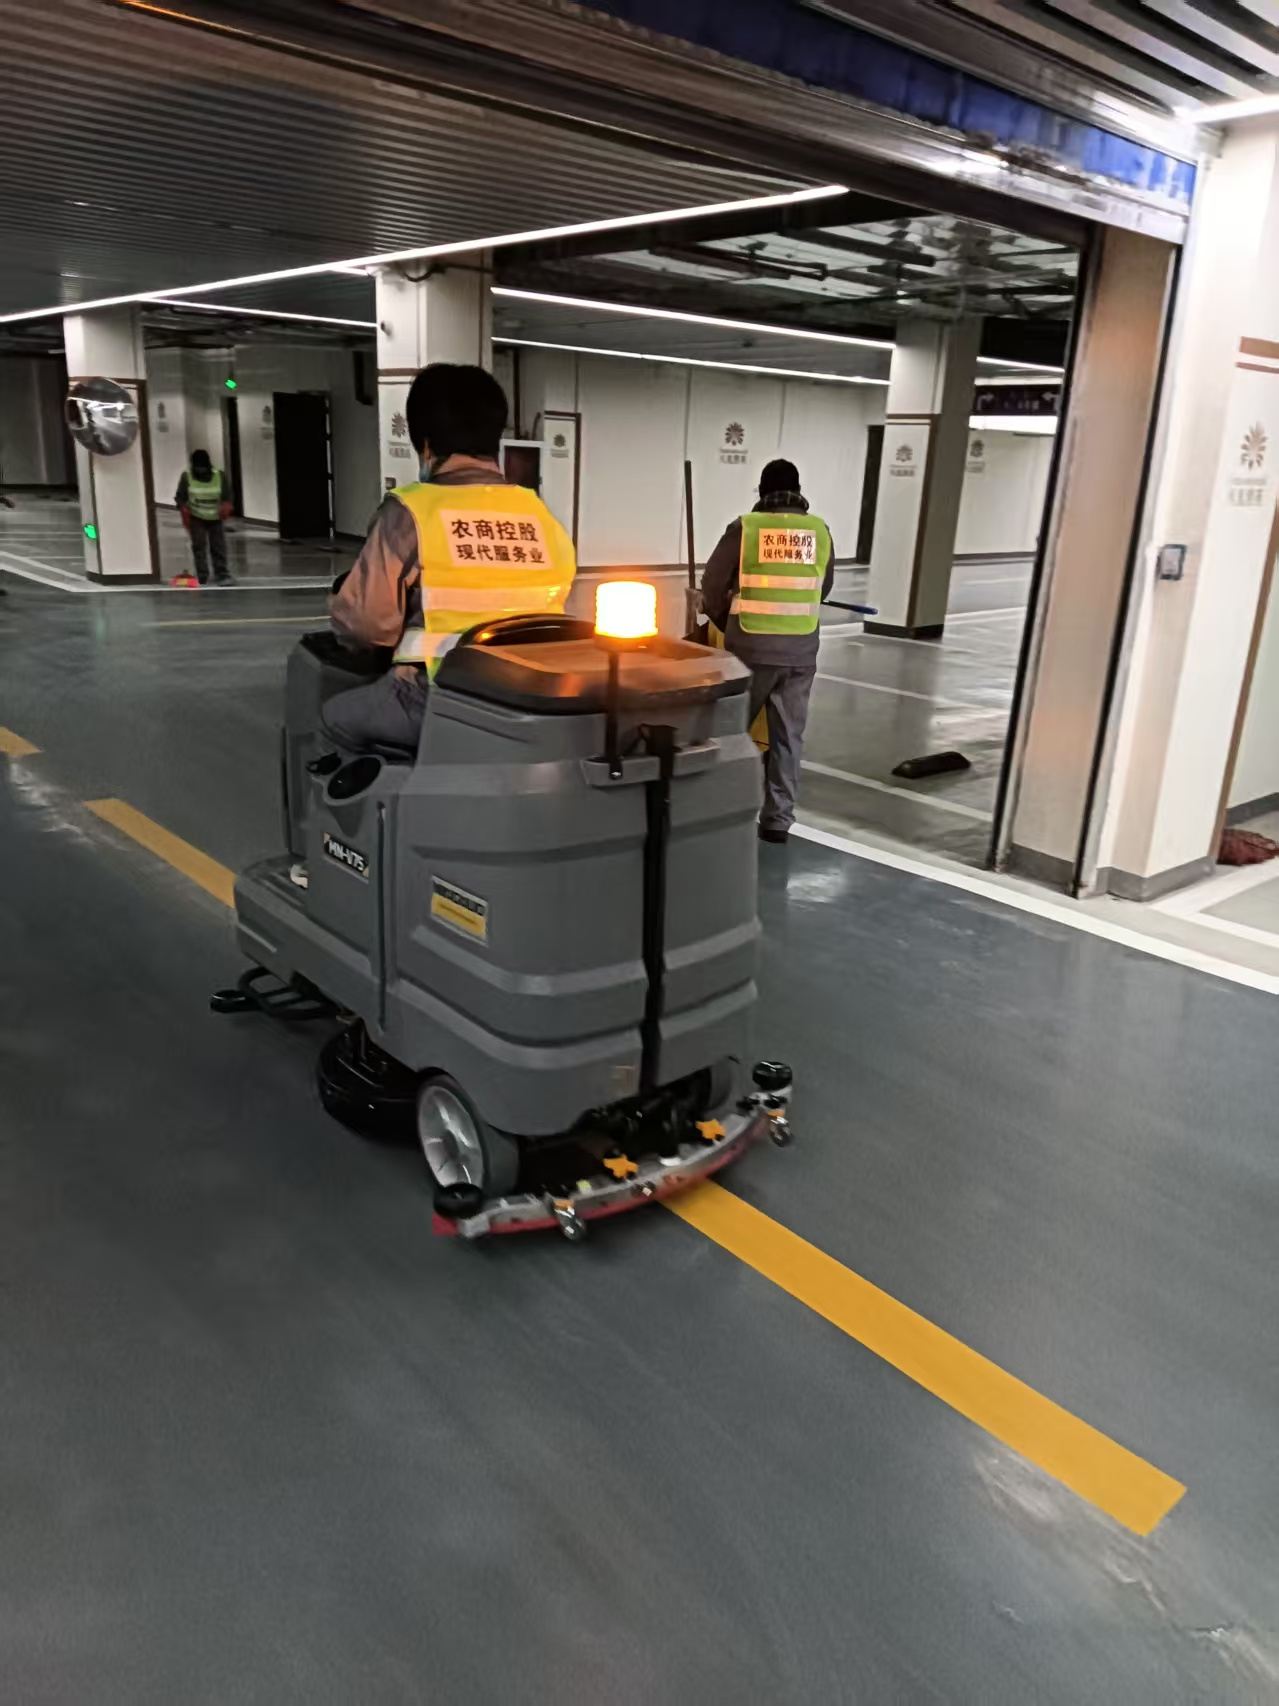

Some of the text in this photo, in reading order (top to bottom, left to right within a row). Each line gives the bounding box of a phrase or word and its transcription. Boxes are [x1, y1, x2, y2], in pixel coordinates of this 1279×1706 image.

[451, 518, 539, 542] 农商控股
[763, 534, 813, 547] 农商控股
[456, 544, 545, 563] 现代服务业
